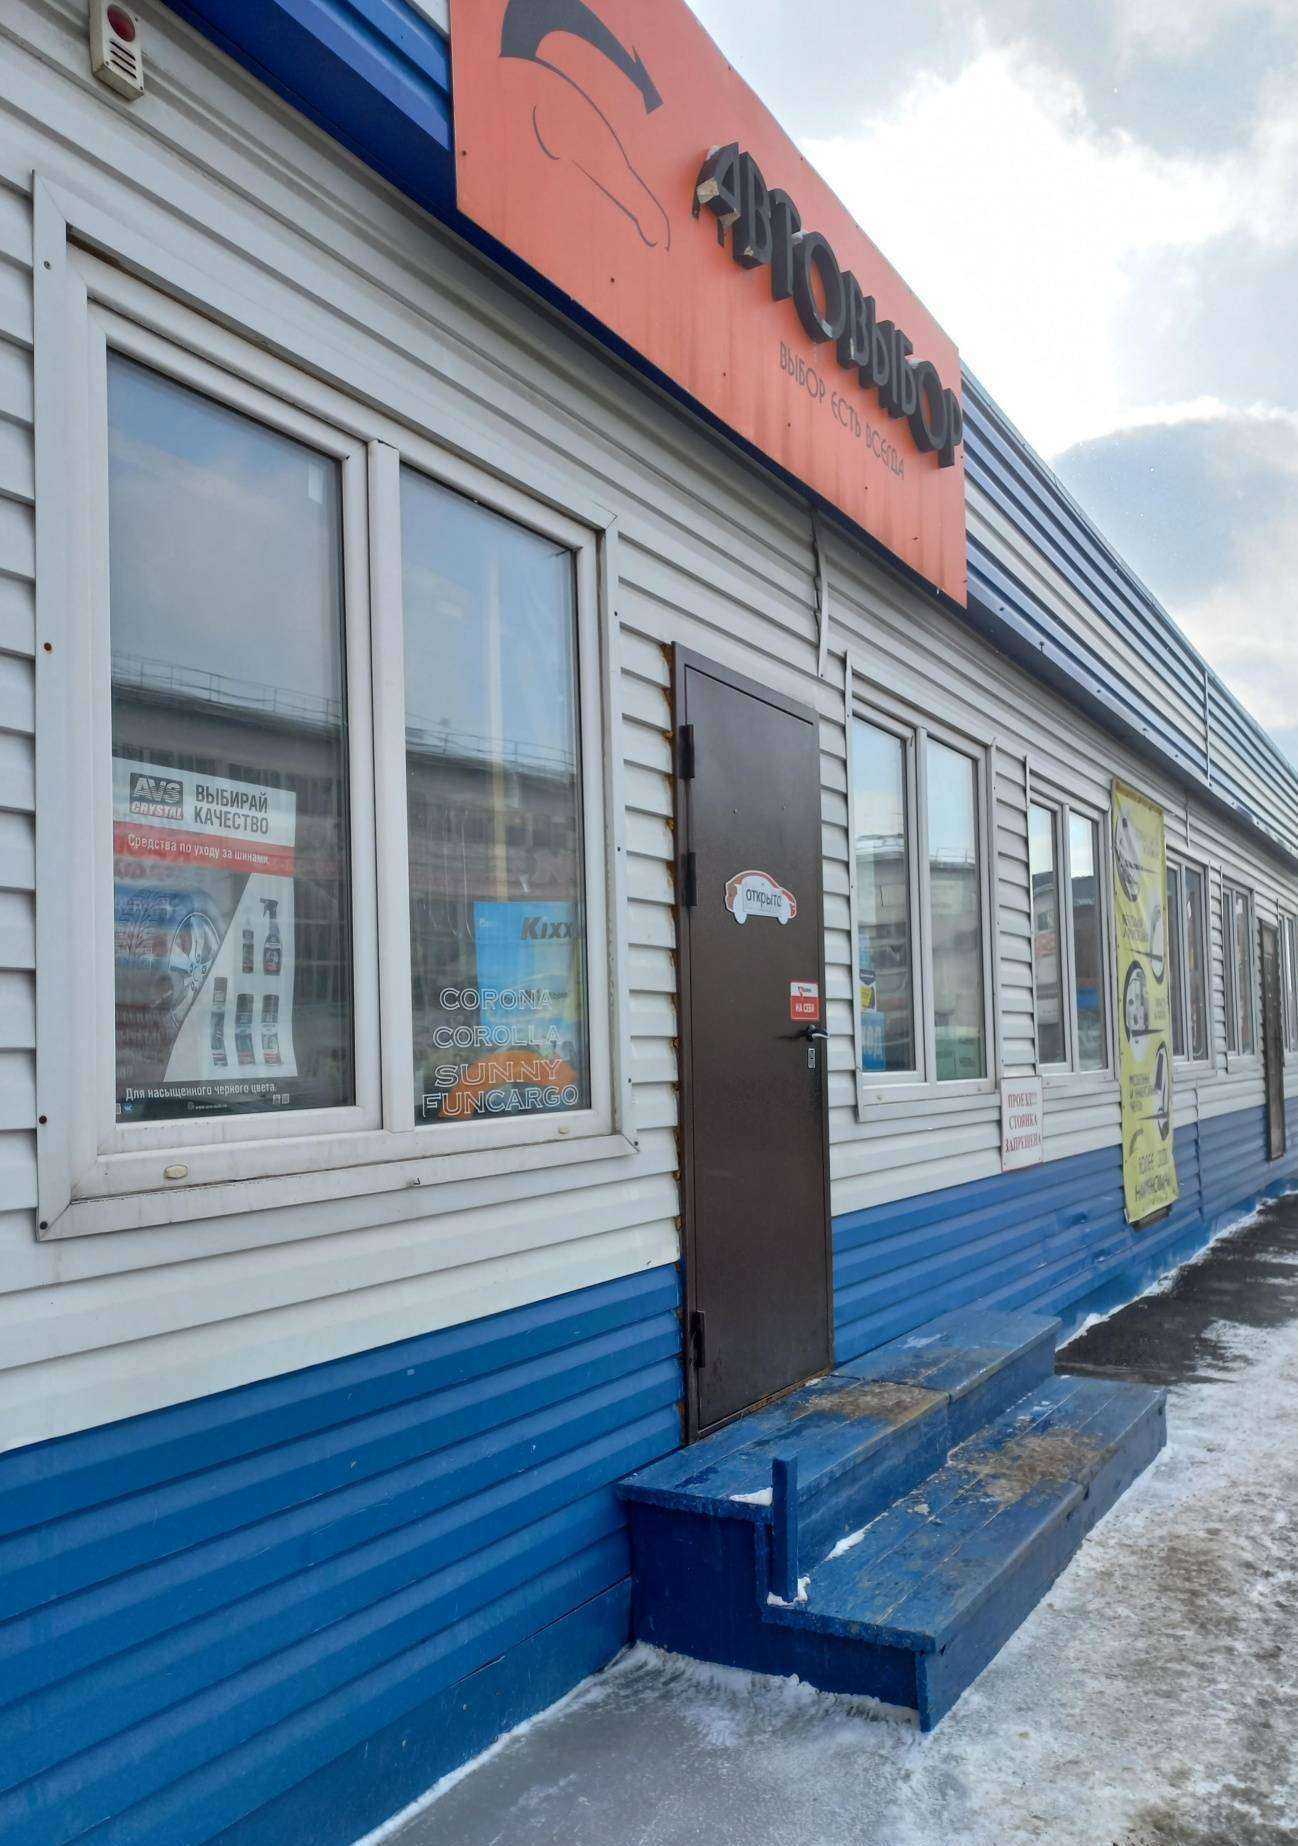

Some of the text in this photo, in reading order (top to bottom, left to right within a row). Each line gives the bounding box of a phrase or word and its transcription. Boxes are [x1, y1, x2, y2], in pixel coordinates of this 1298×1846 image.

[692, 141, 962, 468] АВТОВЫБОР
[779, 341, 904, 480] ВЫБОР ЕСТЬ ВСЕГДА
[132, 776, 181, 803] AVS
[195, 784, 268, 814] ВЫБИРАЙ
[131, 800, 183, 820] CRYSTAL
[194, 805, 269, 835] КАЧЕСТВО
[128, 833, 270, 866] Средства по уходу за шинами
[520, 916, 573, 940] Kixx
[439, 987, 553, 1011] CORONA
[432, 1025, 562, 1049] COROLLA
[434, 1058, 564, 1088] SUNNY
[125, 1087, 145, 1101] Для
[147, 1086, 213, 1100] насыщенного
[214, 1084, 249, 1096] черного
[422, 1084, 579, 1117] FUNCARGO
[1008, 1113, 1039, 1130] СТОЯНКА
